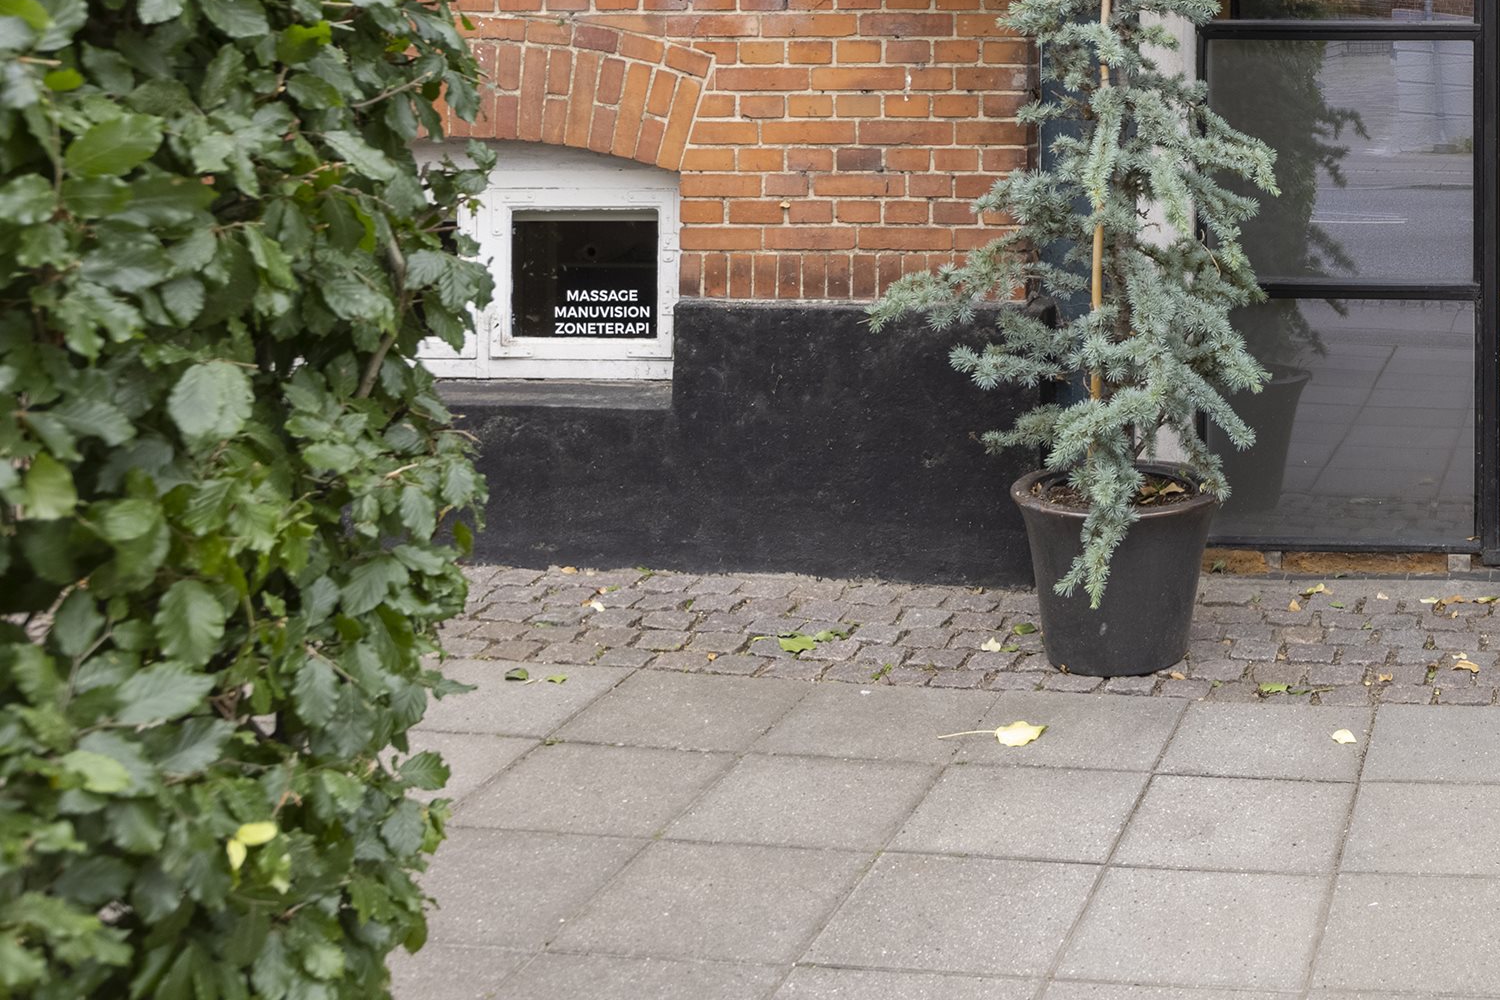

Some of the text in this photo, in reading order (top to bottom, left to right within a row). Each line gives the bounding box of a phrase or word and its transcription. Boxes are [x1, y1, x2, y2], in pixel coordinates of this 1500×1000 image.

[566, 289, 639, 302] MASSAGE
[554, 306, 651, 319] MANUVISION
[554, 322, 650, 335] ZONETERAPI
